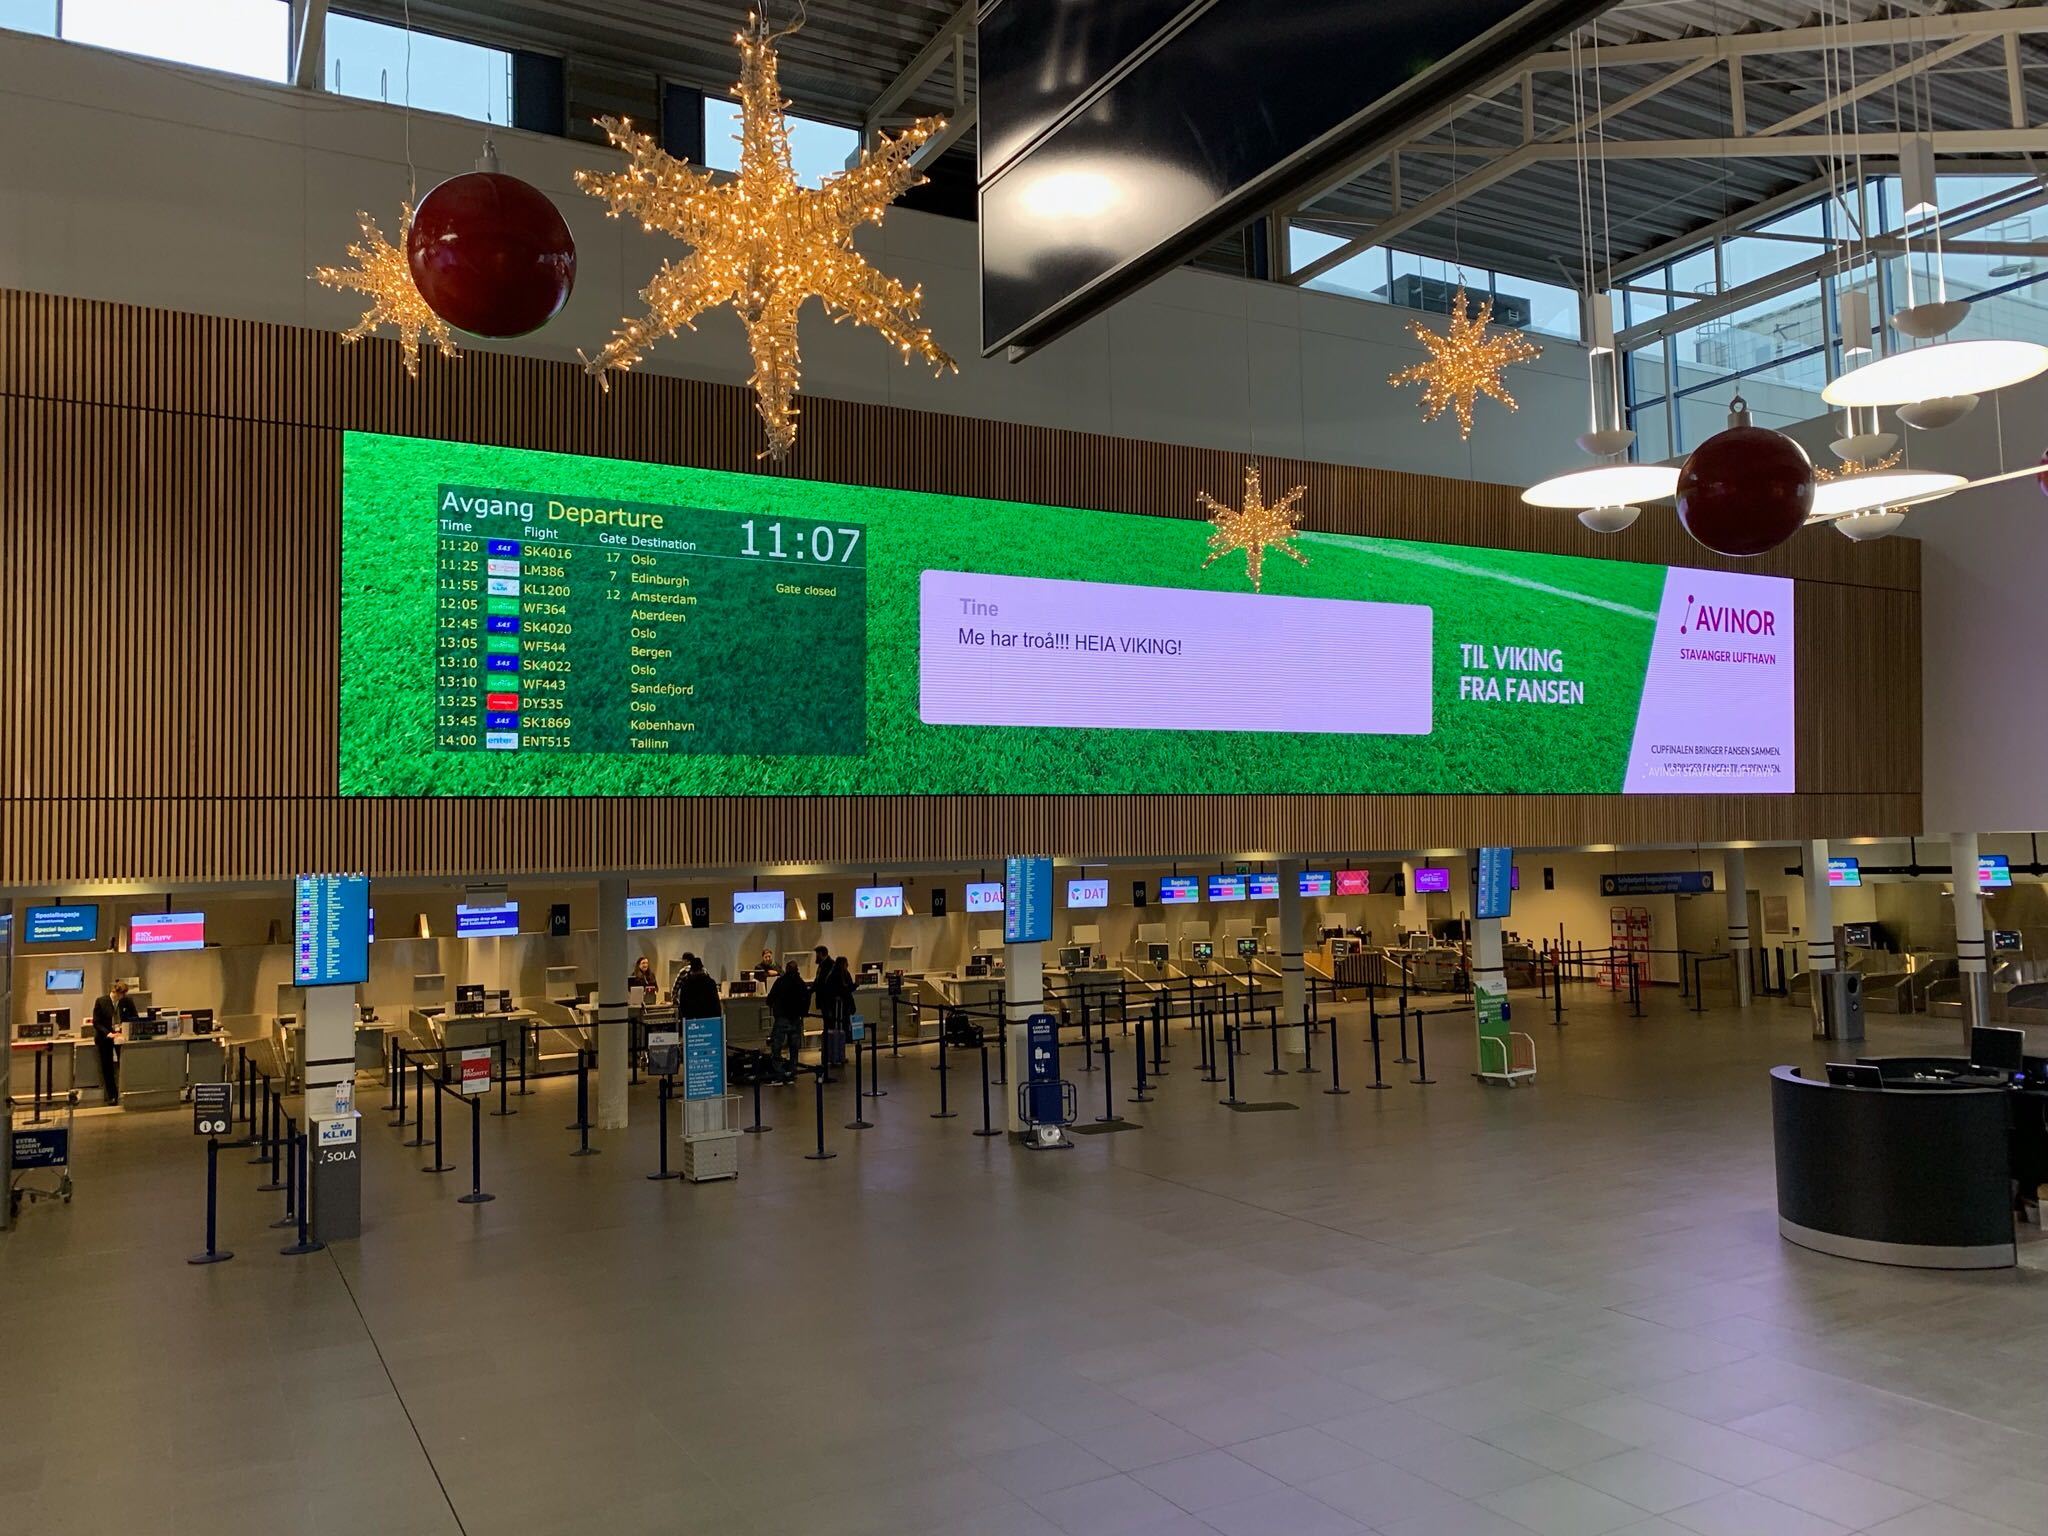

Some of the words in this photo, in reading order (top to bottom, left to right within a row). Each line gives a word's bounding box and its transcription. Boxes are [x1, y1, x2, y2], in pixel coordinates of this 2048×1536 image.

[441, 491, 534, 522] Avgang
[548, 500, 664, 529] Departure
[439, 519, 472, 532] Time
[524, 526, 559, 540] Flight
[599, 533, 627, 545] Gate
[631, 535, 697, 550] Destination
[741, 519, 860, 563] 11:07
[440, 539, 479, 552] 11:20
[524, 546, 572, 559] SK4016
[606, 553, 621, 563] 17
[631, 554, 657, 566] Oslo
[440, 559, 479, 571] 11:25
[524, 565, 565, 577] LM386
[610, 571, 617, 581] 7
[631, 573, 690, 588] Edinburgh
[440, 579, 478, 591] 11:55
[524, 584, 570, 597] KL1200
[606, 589, 621, 600] 12
[631, 591, 697, 605] Amsterdam
[776, 583, 801, 595] Gate
[804, 585, 837, 597] closed
[440, 598, 478, 610] 12:05
[523, 603, 566, 615] WF364
[631, 609, 686, 622] Aberdeen
[960, 598, 999, 616] Tine
[440, 618, 478, 630] 12:45
[523, 622, 572, 635] SK4020
[631, 628, 657, 639] Oslo
[1696, 605, 1775, 636] AVINOR
[440, 637, 478, 649] 13:05
[523, 641, 566, 653] WF544
[631, 646, 672, 660] Bergen
[958, 628, 985, 645] Me
[991, 630, 1018, 648] har
[1023, 632, 1069, 649] troå!!!
[1075, 634, 1116, 652] HEIA
[1119, 636, 1182, 655] VIKING!
[439, 657, 478, 669] 13:10
[523, 660, 572, 672] SK4022
[631, 664, 657, 676] Oslo
[1460, 643, 1489, 669] TIL
[1493, 645, 1563, 672] VIKING
[1680, 648, 1731, 663] STAVANGER
[1732, 651, 1776, 664] LUFTHAVN
[439, 676, 477, 688] 13:10
[523, 679, 566, 691] WF443
[631, 682, 694, 697] Sandefjord
[1460, 675, 1501, 701] FRA
[1505, 677, 1584, 704] FANSEN
[439, 695, 477, 707] 13:25
[523, 698, 564, 710] DY535
[631, 701, 657, 712] Oslo
[439, 715, 477, 727] 13:45
[523, 717, 571, 728] SK1869
[631, 720, 695, 732] København
[439, 734, 477, 746] 14:00
[523, 736, 571, 748] ENT515
[630, 738, 669, 749] Tallinn
[1651, 744, 1694, 755] CUPFINALEN
[1694, 745, 1724, 755] BRINGER
[1724, 746, 1751, 756] FANSEN
[874, 895, 900, 908] DAT
[1084, 888, 1105, 900] DAT
[820, 903, 831, 911] 06
[555, 916, 566, 925] 04
[322, 1129, 352, 1140] KLM
[327, 1150, 357, 1162] SOLA
